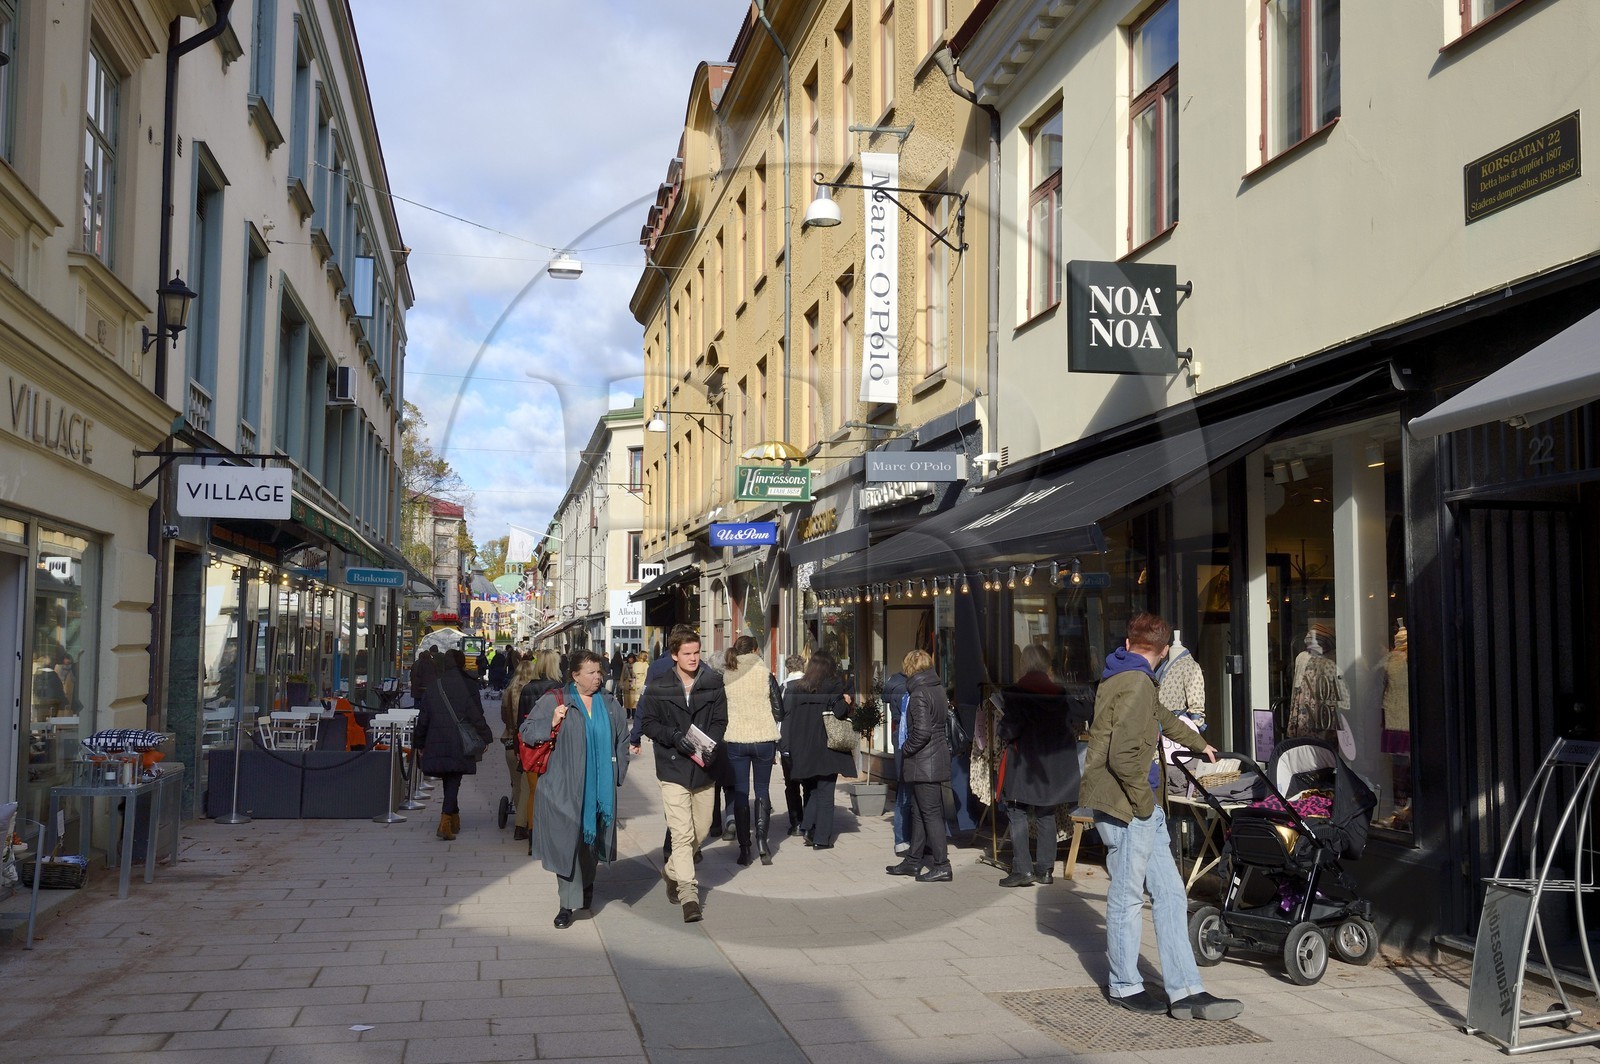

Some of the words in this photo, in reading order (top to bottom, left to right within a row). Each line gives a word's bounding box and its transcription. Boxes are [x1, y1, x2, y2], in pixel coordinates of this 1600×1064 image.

[1481, 137, 1545, 178] KORSGATAN
[1547, 129, 1561, 146] 22
[1480, 178, 1499, 193] Detta
[1498, 173, 1511, 183] hus
[1510, 168, 1518, 177] är
[1519, 156, 1544, 175] uppfört
[1545, 146, 1562, 163] 1807
[1471, 195, 1499, 212] Stadens
[1496, 177, 1539, 202] domprosthus
[870, 172, 891, 260] Marc
[1089, 318, 1163, 349] NOA
[9, 375, 94, 465] VILLAGE
[1529, 435, 1555, 465] 22
[872, 460, 906, 472] Marc
[911, 460, 952, 472] O'Polo
[186, 482, 284, 502] VILLAGE
[716, 527, 770, 541] Ur&Penn
[353, 572, 399, 585] Bankomat
[622, 617, 637, 625] Guld
[1485, 900, 1513, 1017] NÖJESGUIDEN
